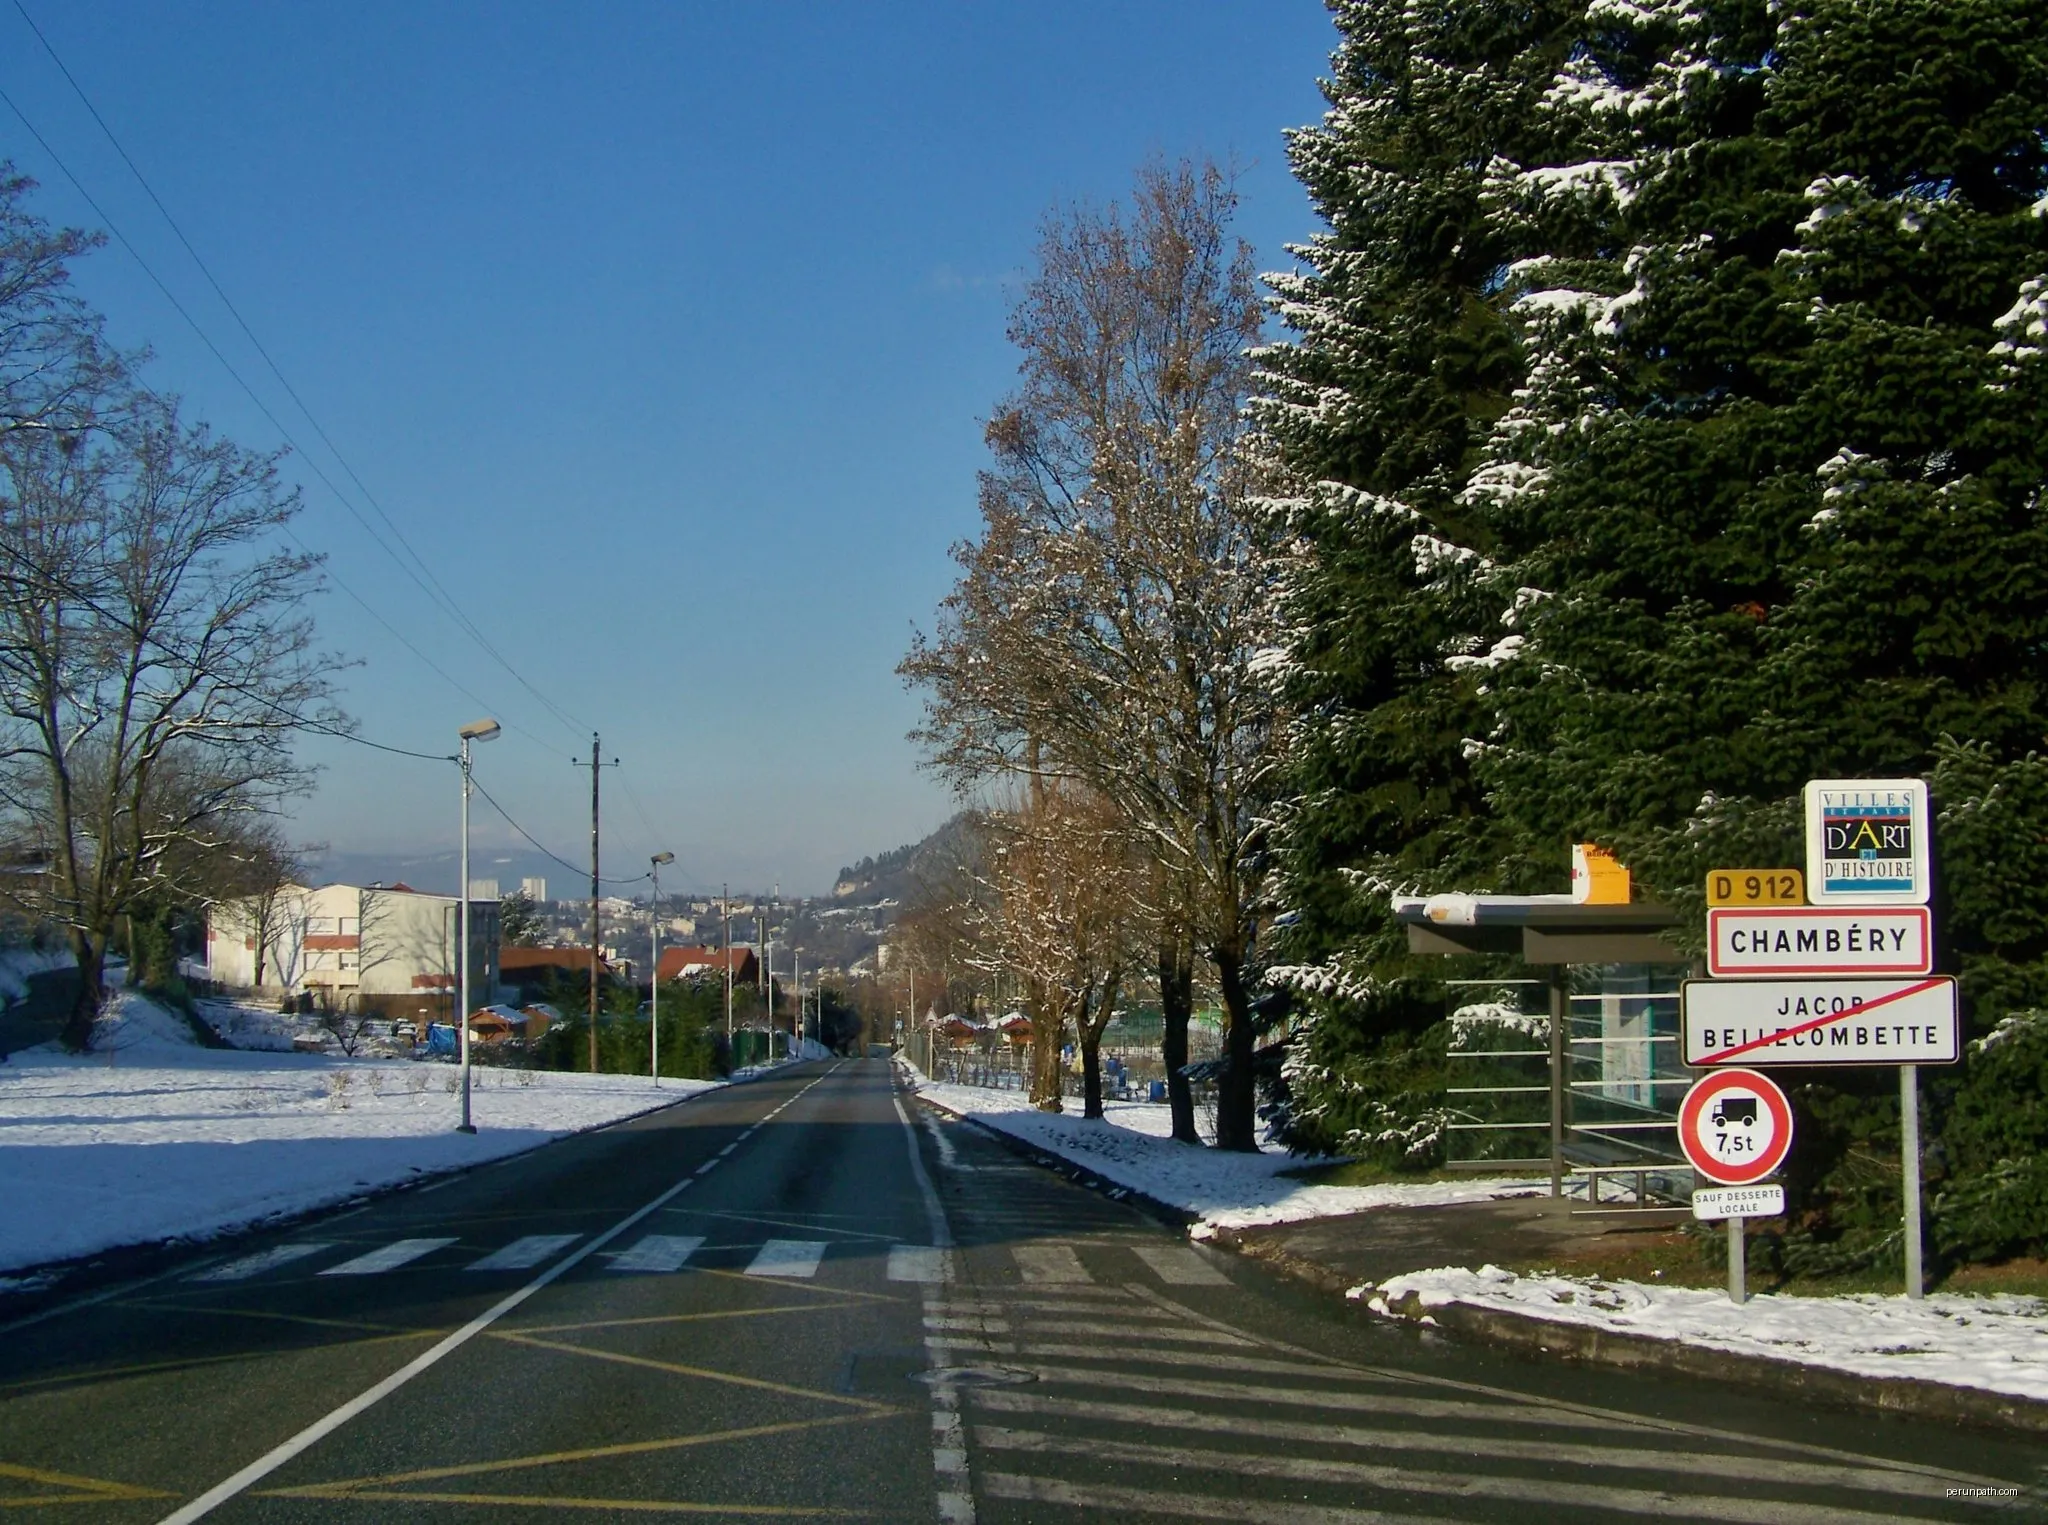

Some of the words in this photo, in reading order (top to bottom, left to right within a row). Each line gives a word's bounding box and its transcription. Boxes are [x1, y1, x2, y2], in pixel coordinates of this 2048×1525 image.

[1824, 792, 1911, 806] VILLES
[1826, 820, 1910, 850] D'ART
[1861, 849, 1876, 860] ET
[1716, 877, 1732, 900] D
[1745, 876, 1796, 900] 912
[1731, 923, 1907, 953] CHAMBÉRY
[1777, 996, 1863, 1015] JACOB
[1703, 1026, 1938, 1048] BELLECOMBETTE
[1695, 1193, 1722, 1203] SAUF
[1727, 1189, 1781, 1201] DESSERTE
[1719, 1203, 1758, 1214] LOCALE
